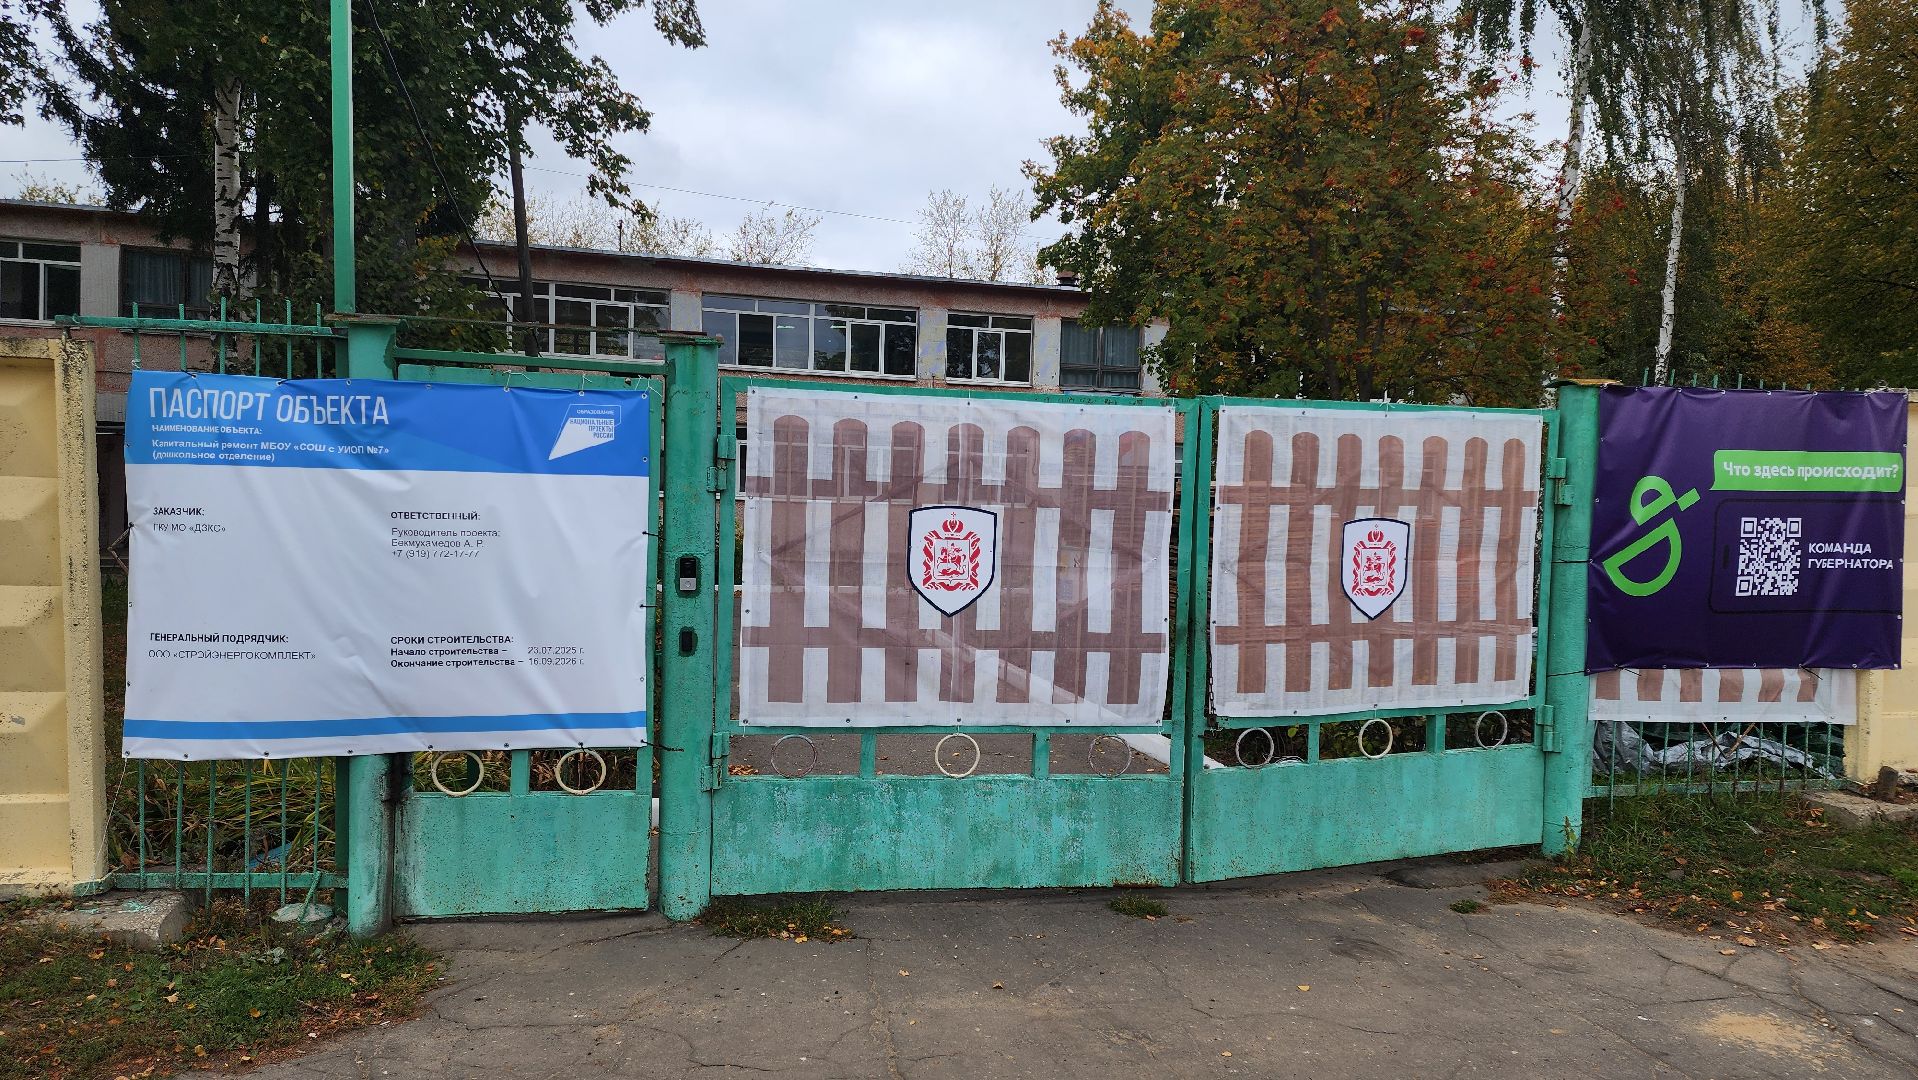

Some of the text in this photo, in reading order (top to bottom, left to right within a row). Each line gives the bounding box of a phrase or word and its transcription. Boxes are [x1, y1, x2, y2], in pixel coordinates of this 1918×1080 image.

[149, 387, 389, 425] ПАСПОРТ ОБЪЕКТА
[152, 425, 263, 435] НАИМЕНОВАНИЕ ОБЪЕКТА:
[152, 439, 219, 449] Капитальный
[221, 442, 258, 450] ремонт
[260, 441, 291, 450] МБОУ
[293, 443, 326, 452] «СОШ
[337, 445, 364, 454] УИОП
[366, 445, 389, 455] №7»
[152, 450, 275, 463] (дошкольное отделение)
[1723, 461, 1899, 481] Что здесь происходит?
[153, 507, 205, 516] ЗАКАЗЧИК:
[391, 511, 480, 520] ОТВЕТСТВЕННЫЙ:
[153, 524, 226, 534] ГКУ МО «ДЗКС»
[391, 528, 457, 537] Руководитель
[392, 549, 480, 559] +7 (919) 772-17-77
[1808, 542, 1872, 555] КОМАНДА
[1808, 558, 1894, 569] ГУБЕРНАТОРА
[150, 632, 289, 644] ГЕНЕРАЛЬНЫЙ ПОДРЯДЧИК:
[391, 635, 514, 644] СРОКИ СТРОИТЕЛЬСТВА:
[149, 649, 316, 660] ООО «СТРОЙЭНЕРГОКОМПЛЕКТ»
[391, 648, 426, 656] Начало
[428, 647, 499, 657] строительства
[528, 646, 577, 654] 23.07.2025
[391, 658, 443, 668] Окончание
[445, 658, 515, 668] строительства
